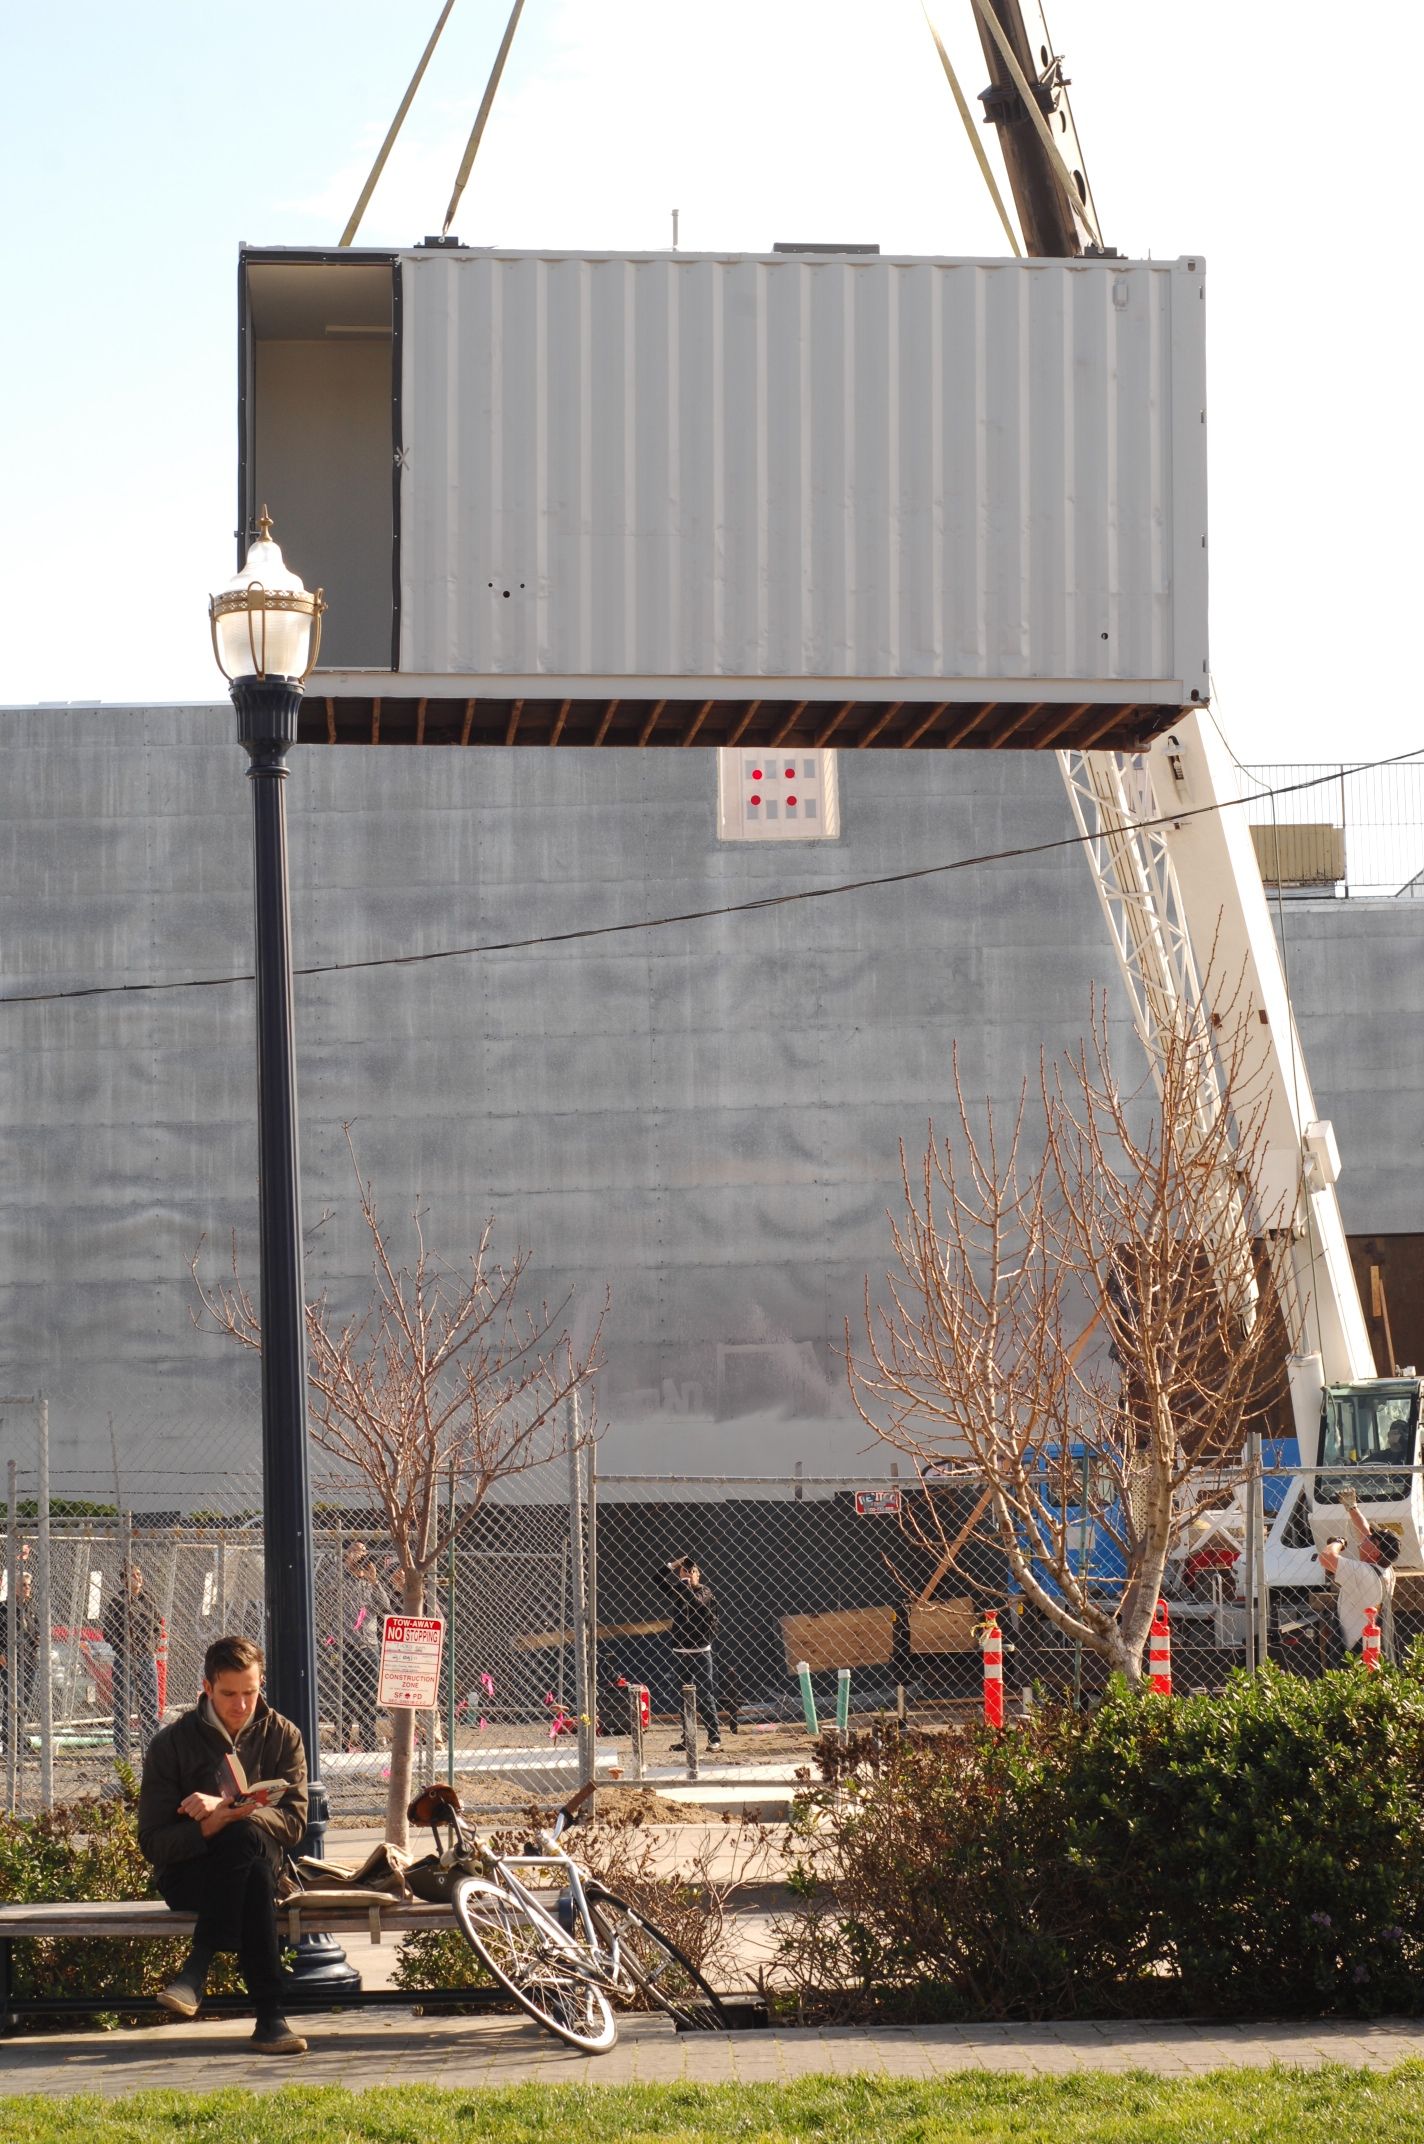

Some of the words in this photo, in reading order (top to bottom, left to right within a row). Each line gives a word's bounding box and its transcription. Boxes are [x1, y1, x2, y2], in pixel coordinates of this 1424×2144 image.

[393, 1619, 434, 1628] TOW-AWAY
[388, 1627, 402, 1640] NO
[406, 1629, 438, 1642] STOPPING
[385, 1674, 434, 1682] CONSTRUCTION
